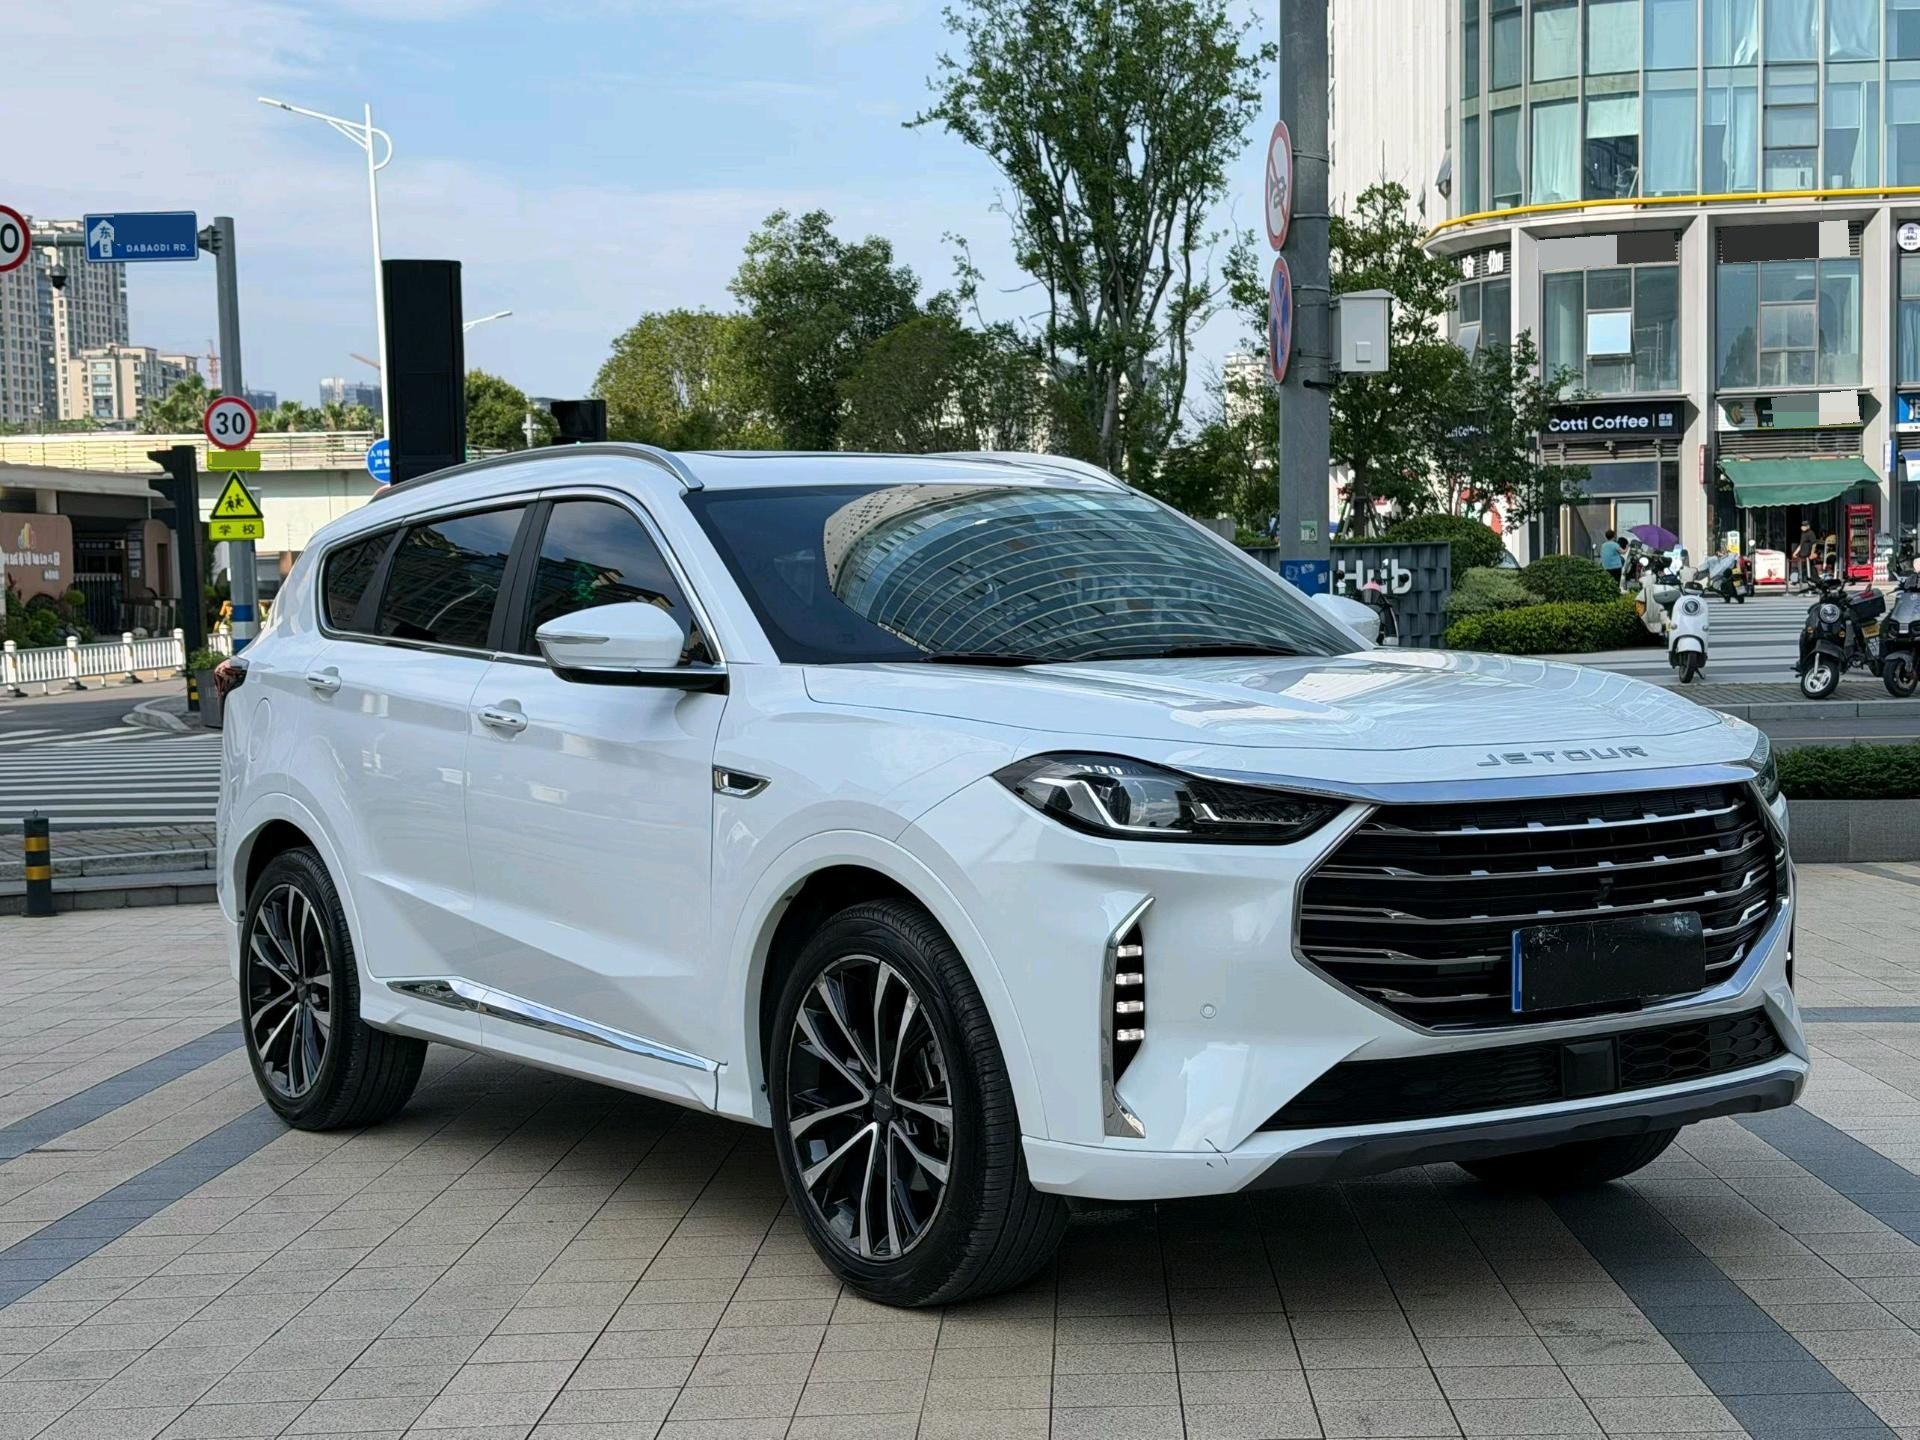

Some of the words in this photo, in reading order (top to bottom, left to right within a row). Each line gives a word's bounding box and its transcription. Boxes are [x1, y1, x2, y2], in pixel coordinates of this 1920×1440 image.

[100, 226, 112, 239] 东
[102, 243, 109, 253] E
[173, 243, 190, 252] RD.
[216, 412, 246, 435] 30
[1548, 418, 1588, 432] Cotti
[1592, 415, 1649, 429] Coffee
[219, 523, 256, 536] 学校
[1330, 559, 1412, 595] Hub
[1476, 745, 1648, 767] JETOUR
